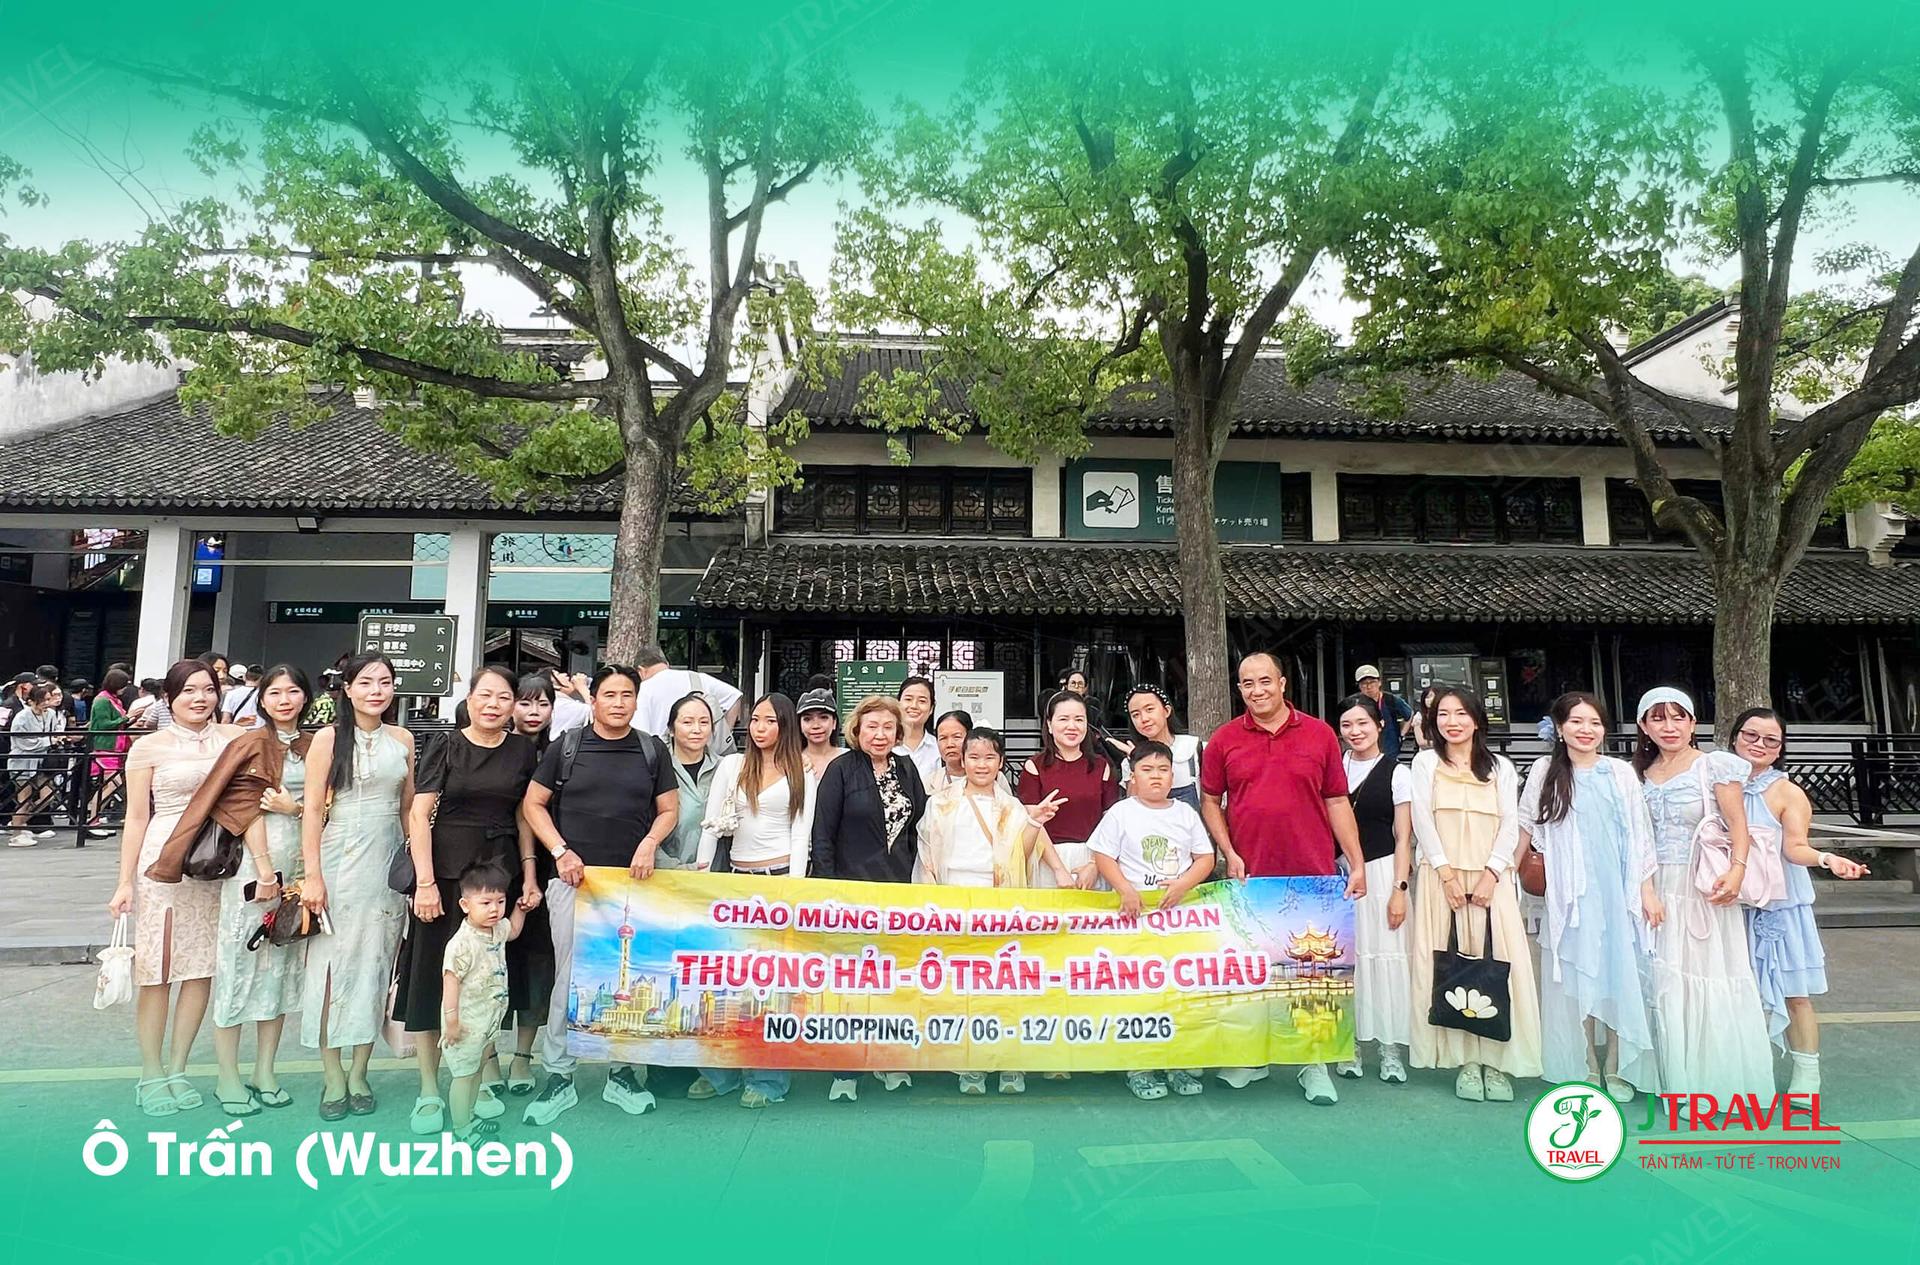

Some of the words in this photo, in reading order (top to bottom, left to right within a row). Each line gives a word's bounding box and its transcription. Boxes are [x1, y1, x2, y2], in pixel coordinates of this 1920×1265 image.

[713, 896, 788, 926] CHÀO
[799, 904, 879, 930] MỪNG
[889, 906, 961, 932] ĐOÀN
[971, 905, 1059, 932] KHÁCH
[1069, 910, 1138, 930] THAM
[1148, 907, 1221, 930] QUAN
[677, 954, 824, 996] THƯỢNG
[834, 950, 891, 988] HẢI
[920, 952, 943, 988] Ô
[951, 945, 1041, 990] TRẤN
[1070, 954, 1165, 990] HÀNG
[1173, 948, 1267, 987] CHÂU
[767, 1017, 797, 1040] NO
[804, 1017, 920, 1045] SHOPPING,
[971, 1018, 999, 1041] 06
[1065, 1018, 1093, 1041] 06
[1116, 1016, 1172, 1040] 2026
